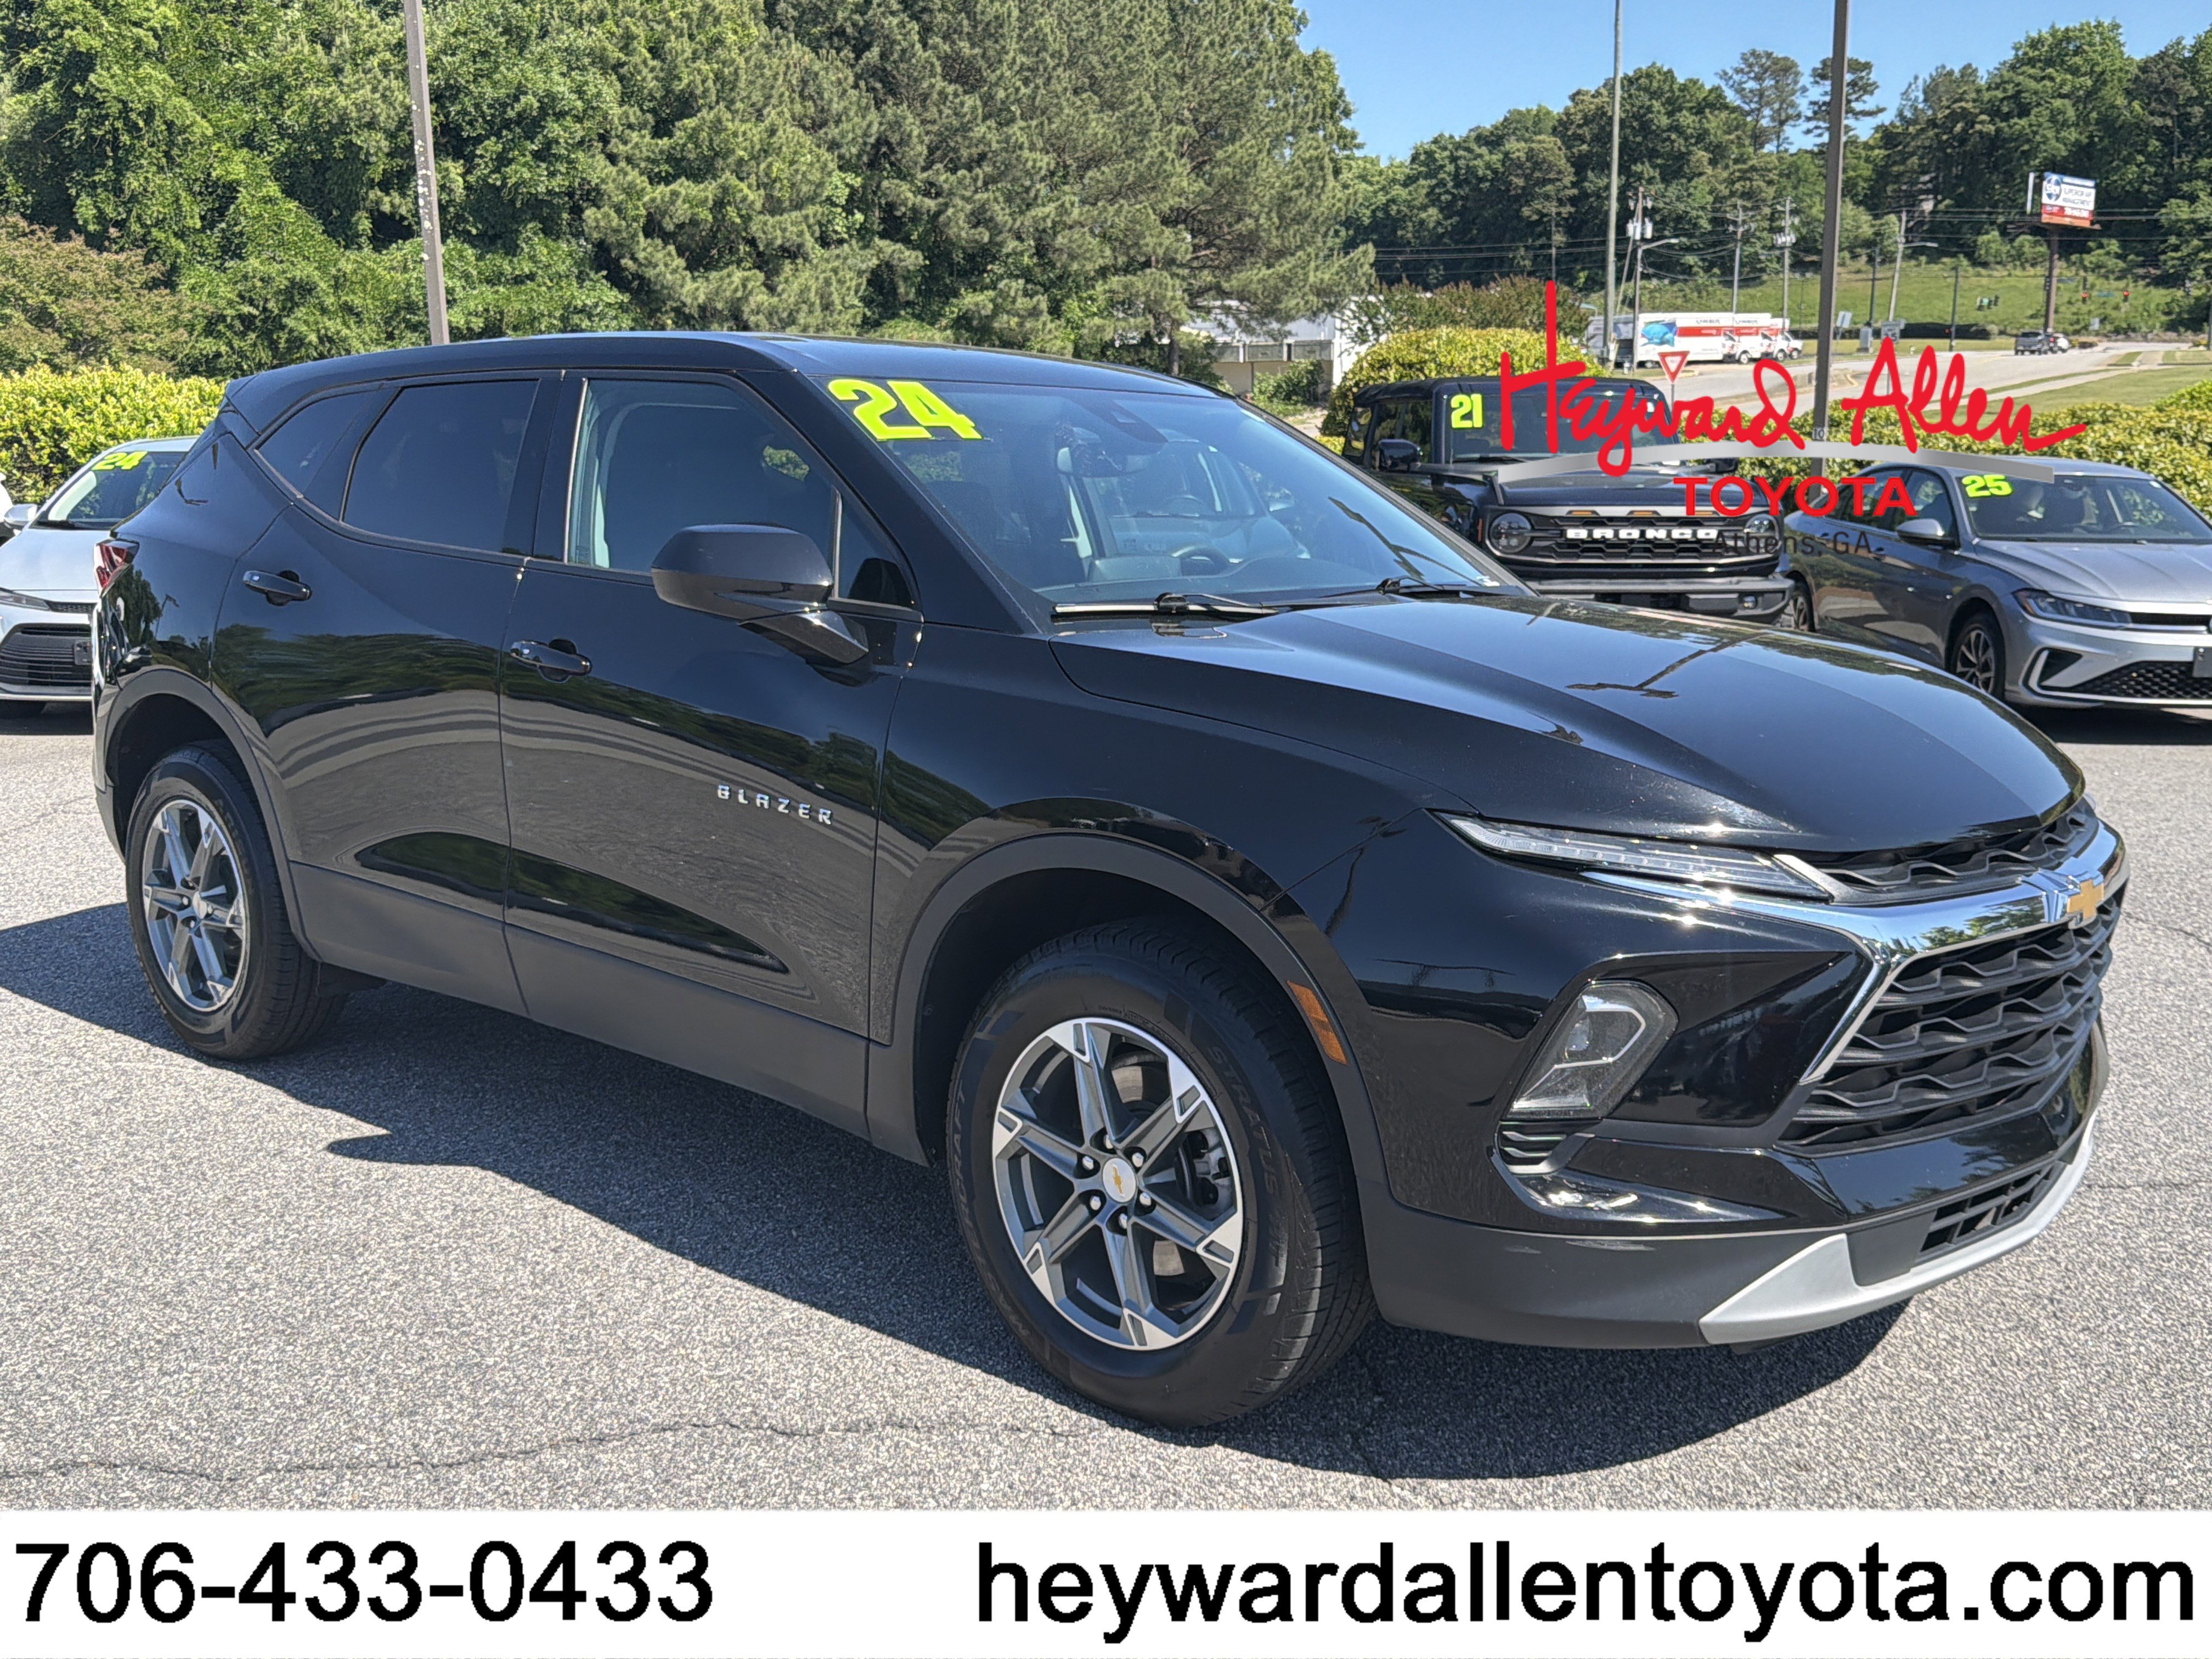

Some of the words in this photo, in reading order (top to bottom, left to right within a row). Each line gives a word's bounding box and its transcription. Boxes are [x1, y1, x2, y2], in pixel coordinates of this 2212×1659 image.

[828, 379, 982, 440] 24
[1451, 393, 1483, 428] 21
[1814, 428, 1825, 440] 10
[91, 451, 148, 470] 24
[1961, 474, 2012, 497] 25
[1566, 528, 1718, 540] BRONCO
[717, 785, 832, 825] BLAZER
[1207, 1045, 1279, 1194] STRATUS
